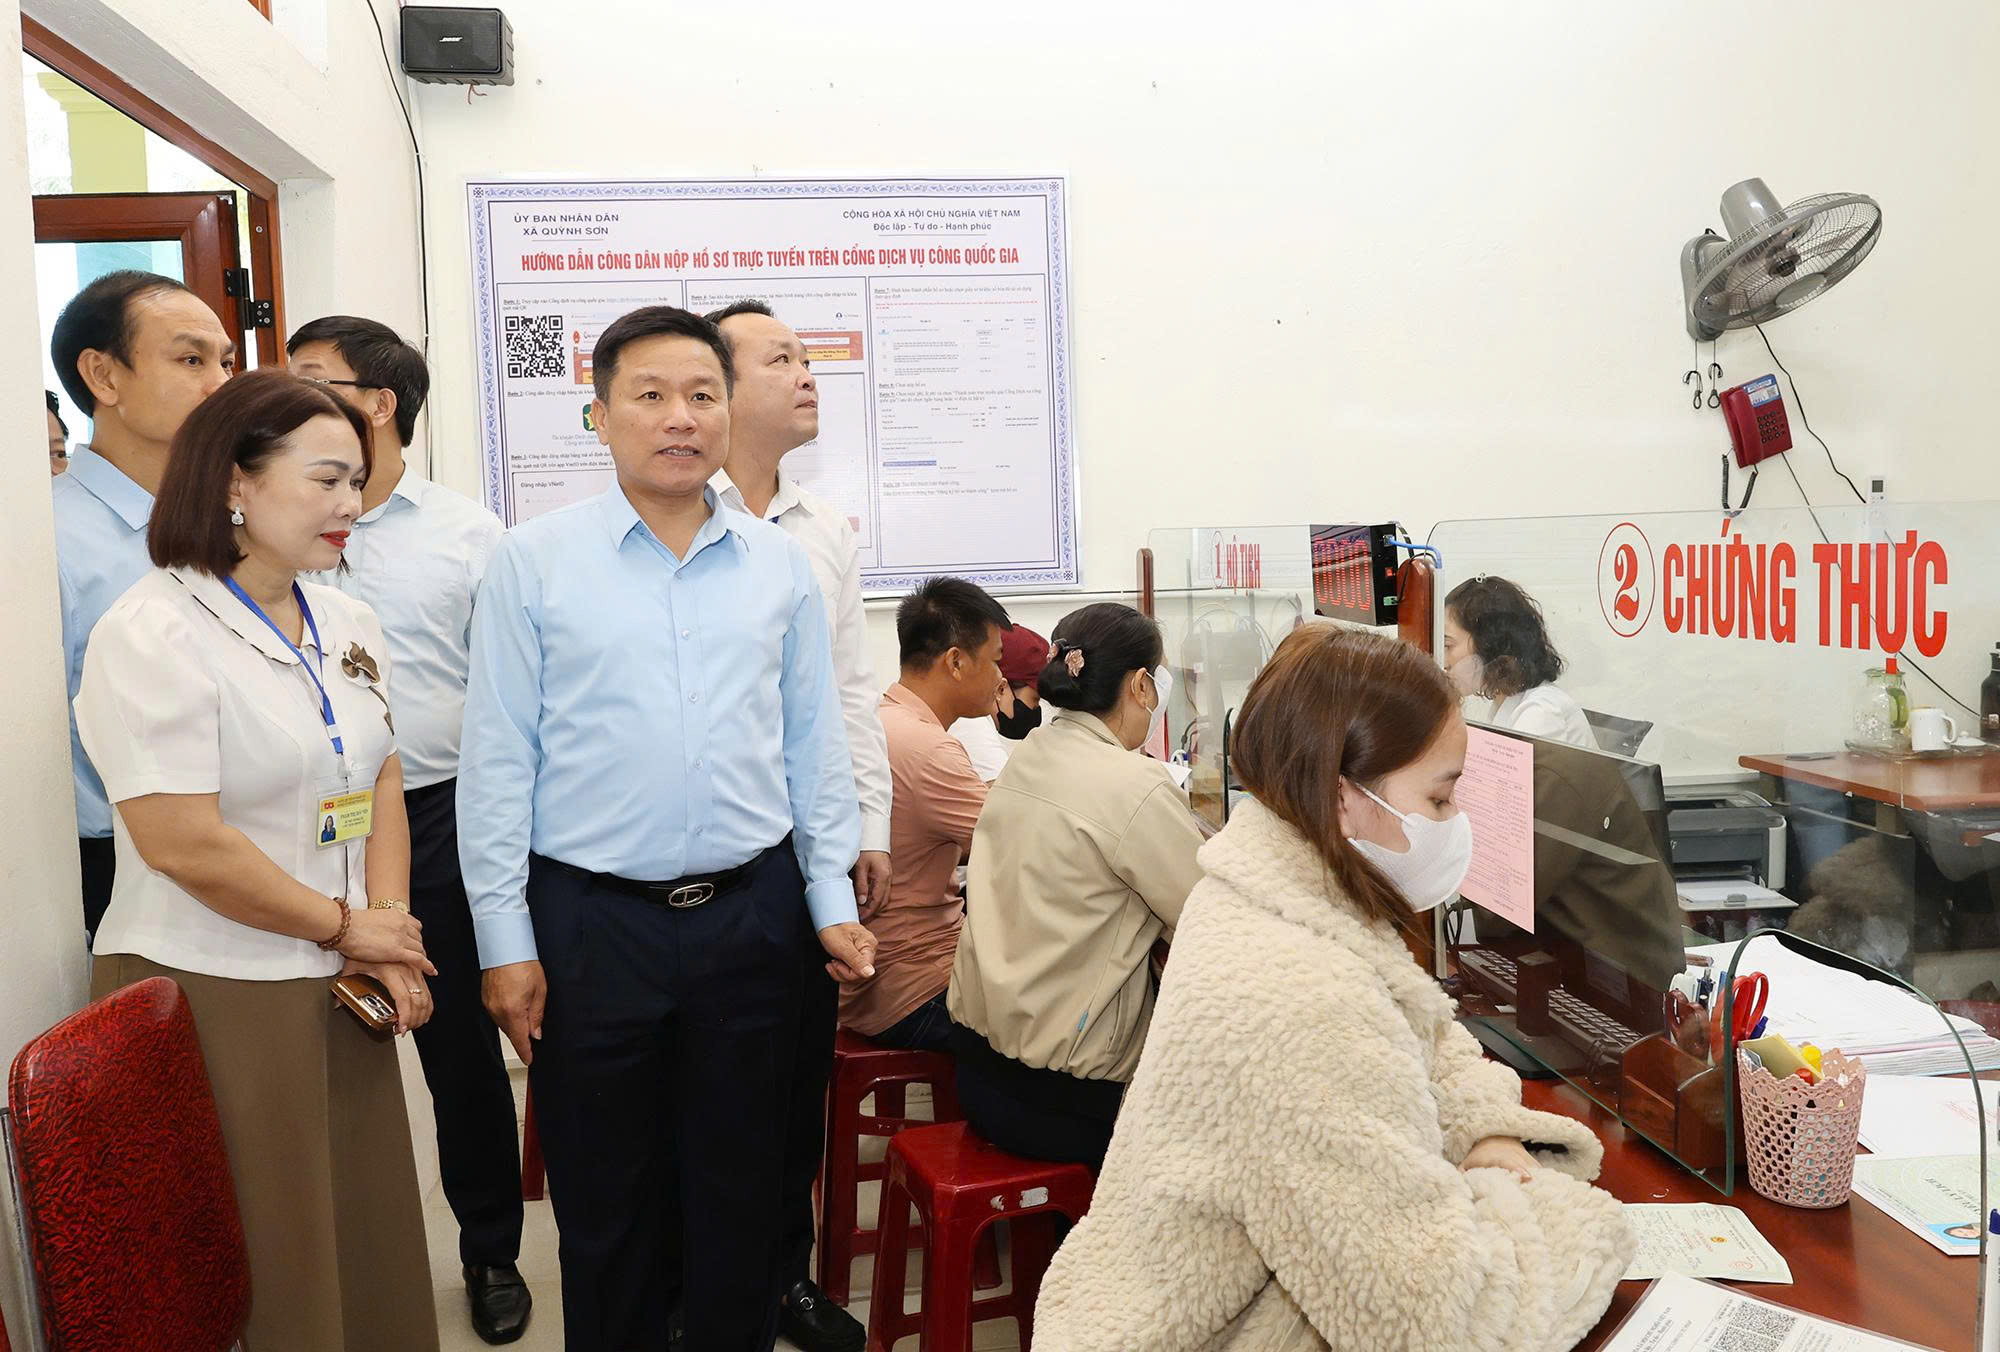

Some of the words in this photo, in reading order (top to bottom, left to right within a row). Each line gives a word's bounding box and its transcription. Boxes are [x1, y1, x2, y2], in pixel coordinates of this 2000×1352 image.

[514, 212, 529, 223] ỦY
[560, 212, 592, 222] NHÂN
[595, 212, 619, 222] DÂN
[843, 209, 870, 219] CỘNG
[872, 208, 891, 218] HÒA
[894, 208, 906, 218] XÃ
[908, 208, 924, 218] HỘI
[926, 208, 946, 218] CHỦ
[948, 208, 976, 218] NGHĨA
[1001, 209, 1021, 217] NAM
[523, 226, 538, 235] XÃ
[541, 225, 582, 236] QUỲNH
[585, 226, 609, 235] SƠN
[873, 223, 890, 231] Độc
[892, 223, 906, 231] lập
[945, 223, 968, 231] Hạnh
[970, 222, 992, 231] phúc
[521, 251, 565, 271] HƯỚNG
[568, 248, 594, 271] DẪN
[597, 250, 631, 270] CÔNG
[635, 249, 660, 269] DÂN
[664, 249, 689, 272] NỘP
[713, 250, 729, 268] SƠ
[732, 249, 763, 271] TRỰC
[767, 245, 805, 267] TUYẾN
[808, 246, 839, 266] TRÊN
[842, 243, 875, 266] CỔNG
[879, 248, 906, 268] DỊCH
[910, 248, 925, 268] VỤ
[928, 245, 961, 264] CÔNG
[964, 242, 996, 266] QUỐC
[999, 248, 1019, 264] GIA
[1613, 542, 1641, 621] 2
[1663, 518, 1797, 643] CHỨNG
[1812, 530, 1949, 675] THỰC
